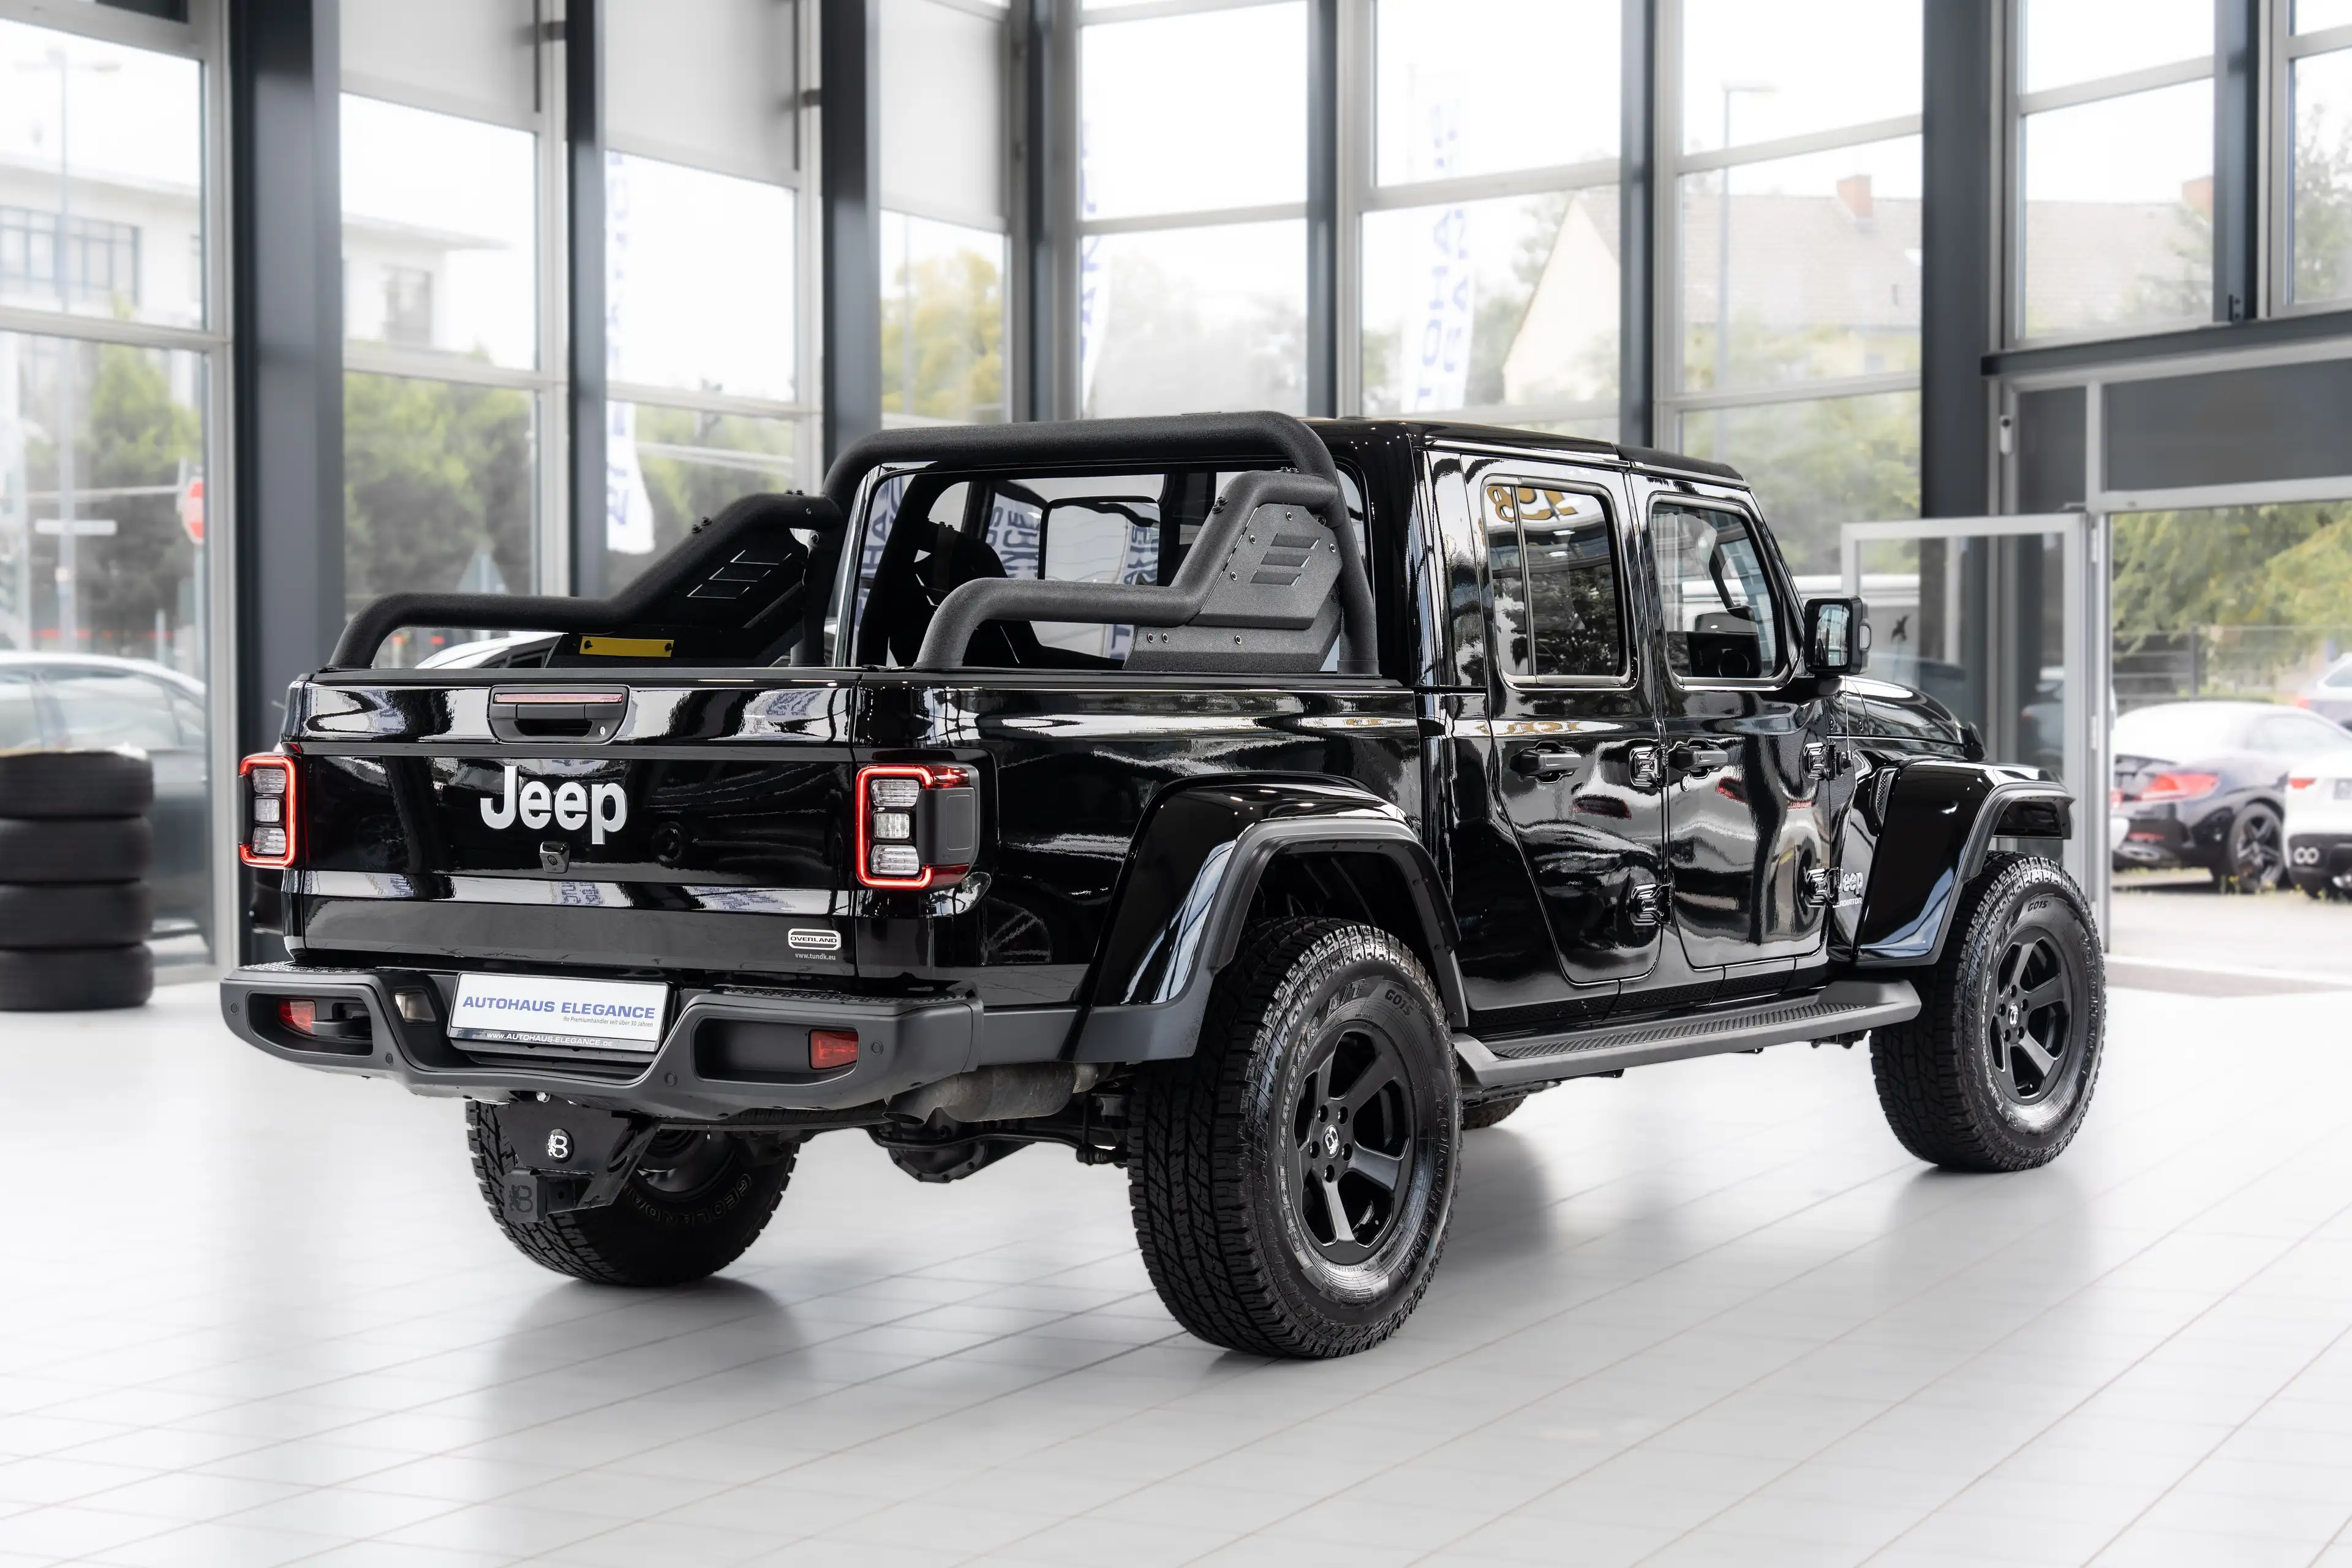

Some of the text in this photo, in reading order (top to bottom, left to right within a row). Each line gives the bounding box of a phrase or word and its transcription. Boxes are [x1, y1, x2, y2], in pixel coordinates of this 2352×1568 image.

[480, 766, 628, 845] Jeep
[1833, 897, 1863, 908] ADIATOR
[2027, 900, 2048, 912] G015
[462, 996, 655, 1019] AUTOHAUS ELEGANCE
[1384, 989, 1414, 1016] G015
